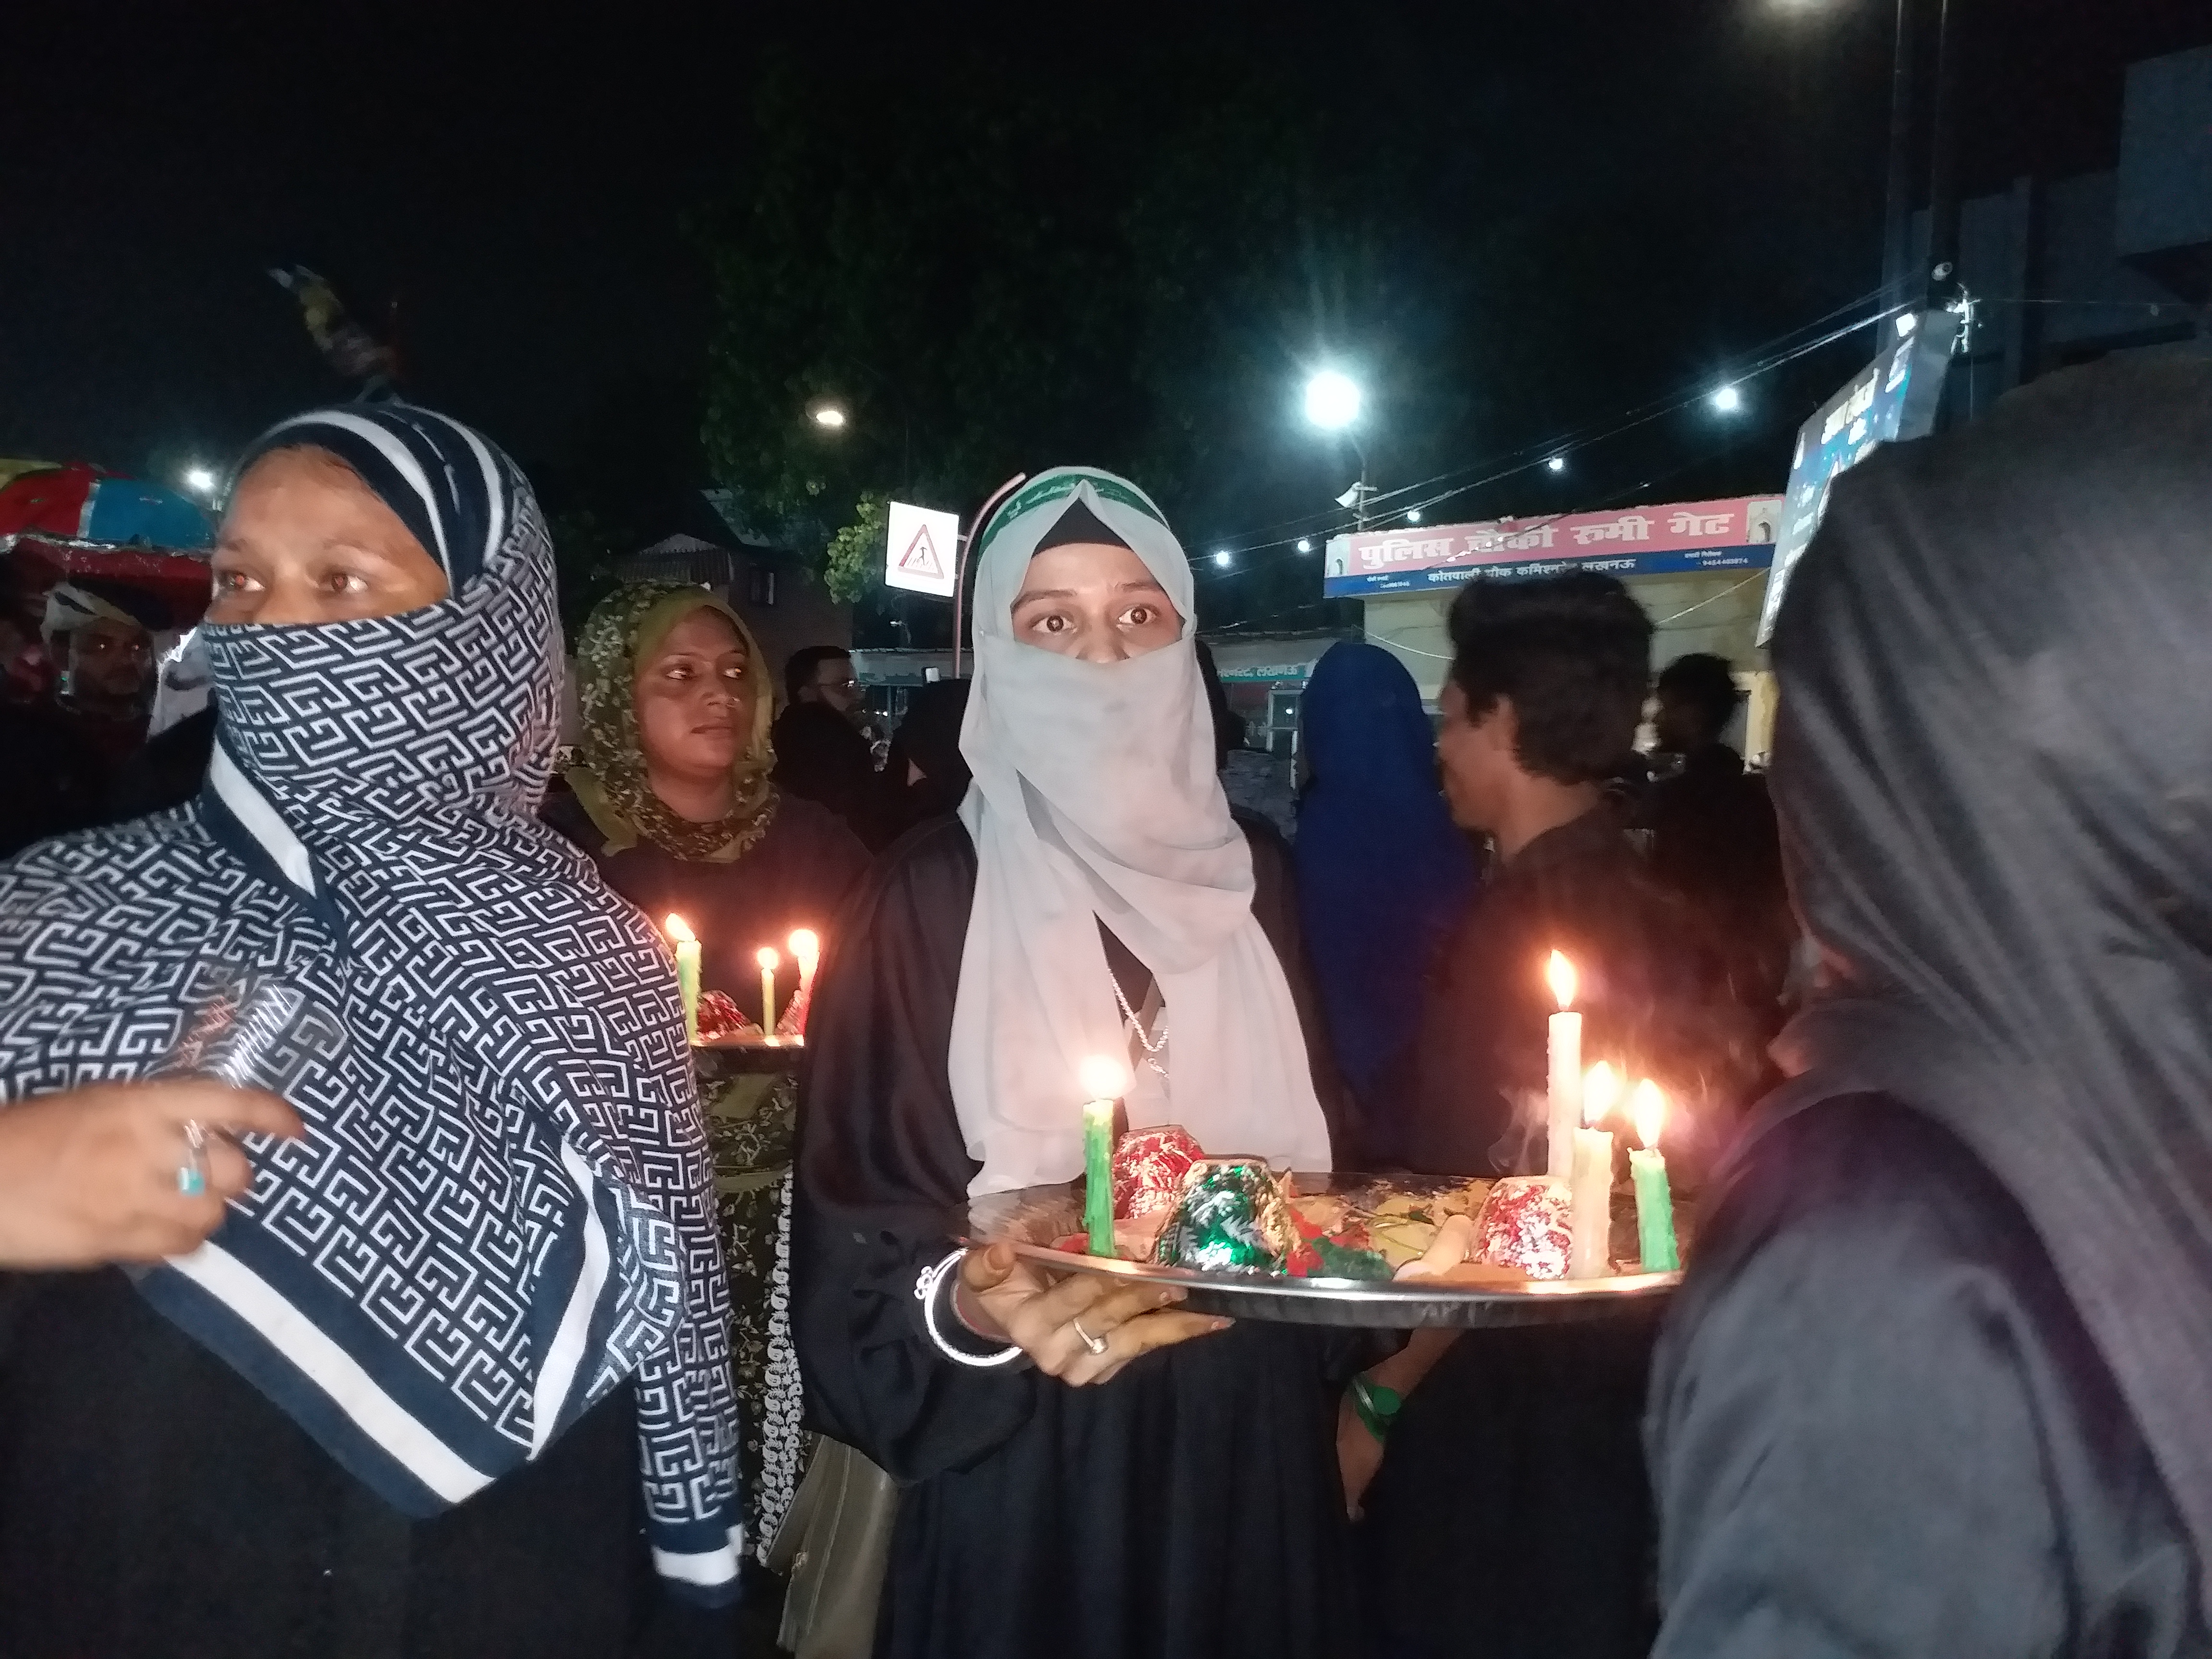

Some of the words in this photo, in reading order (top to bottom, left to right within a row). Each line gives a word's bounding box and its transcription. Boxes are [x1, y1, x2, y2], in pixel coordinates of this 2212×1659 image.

[1358, 538, 1455, 569] पुलिस
[1667, 512, 1734, 536] गेट
[1581, 559, 1636, 571] लखनऊ
